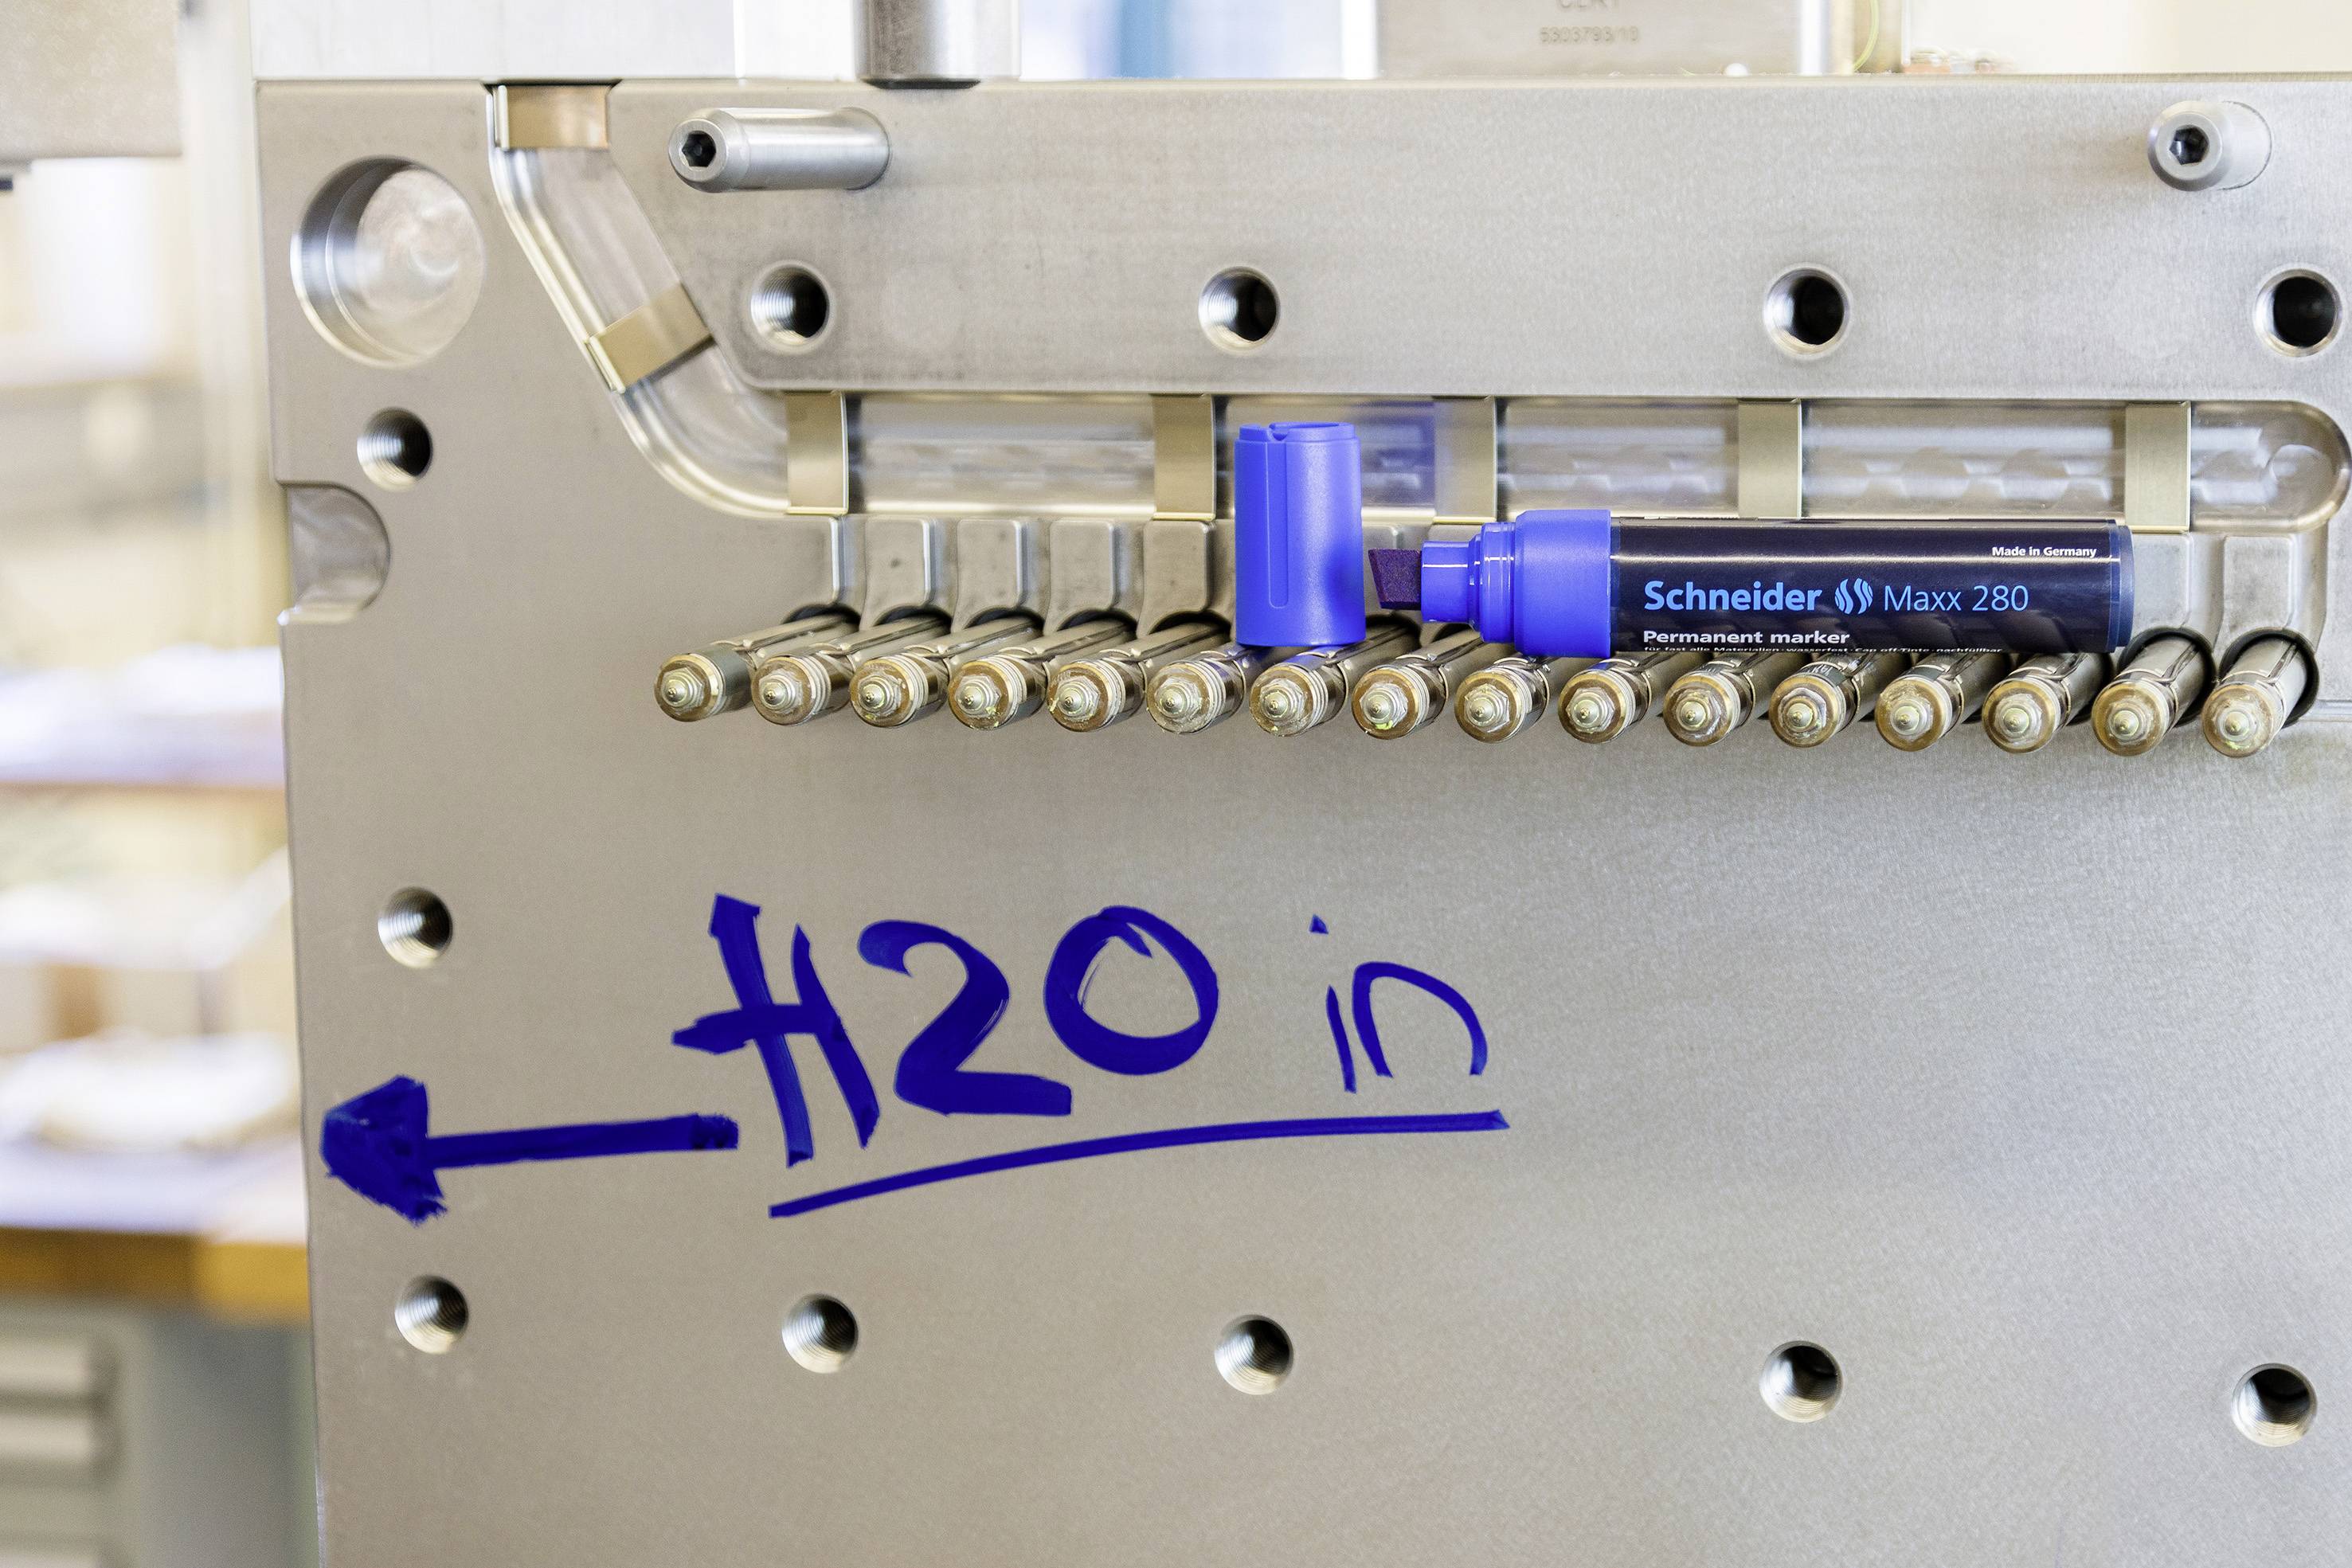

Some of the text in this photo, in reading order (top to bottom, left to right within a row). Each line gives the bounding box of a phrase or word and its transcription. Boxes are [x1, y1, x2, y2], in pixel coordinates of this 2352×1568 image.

[1992, 546, 2097, 558] Made in Germany
[1644, 581, 2029, 612] Schneider Maxx 280
[1643, 630, 1850, 644] Permanent marker
[1309, 914, 1488, 1093] in
